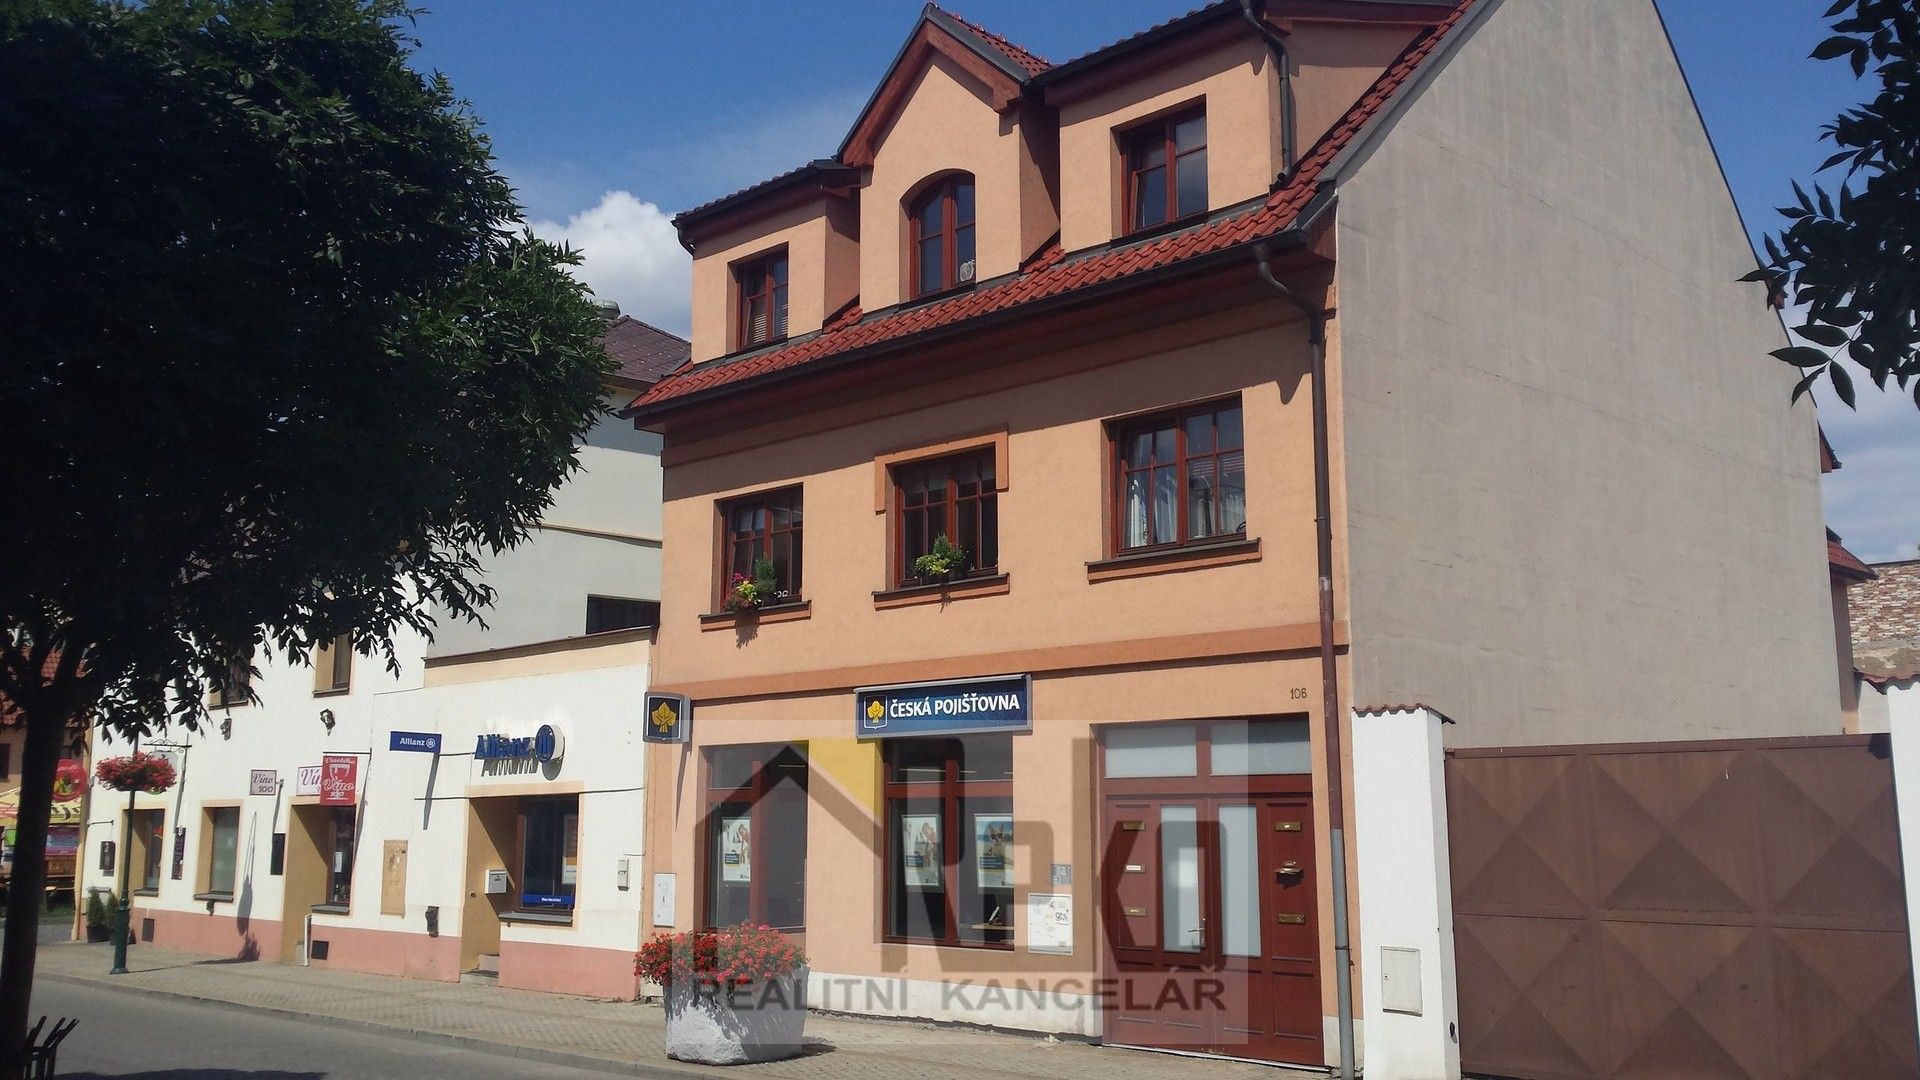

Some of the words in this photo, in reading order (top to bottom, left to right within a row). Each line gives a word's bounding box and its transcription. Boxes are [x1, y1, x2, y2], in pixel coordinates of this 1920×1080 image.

[1290, 688, 1308, 700] 106
[890, 696, 932, 718] ČESKÁ
[935, 693, 1020, 716] POJIŠŤOVNA
[399, 737, 426, 747] Allianz
[474, 733, 533, 760] Allianz
